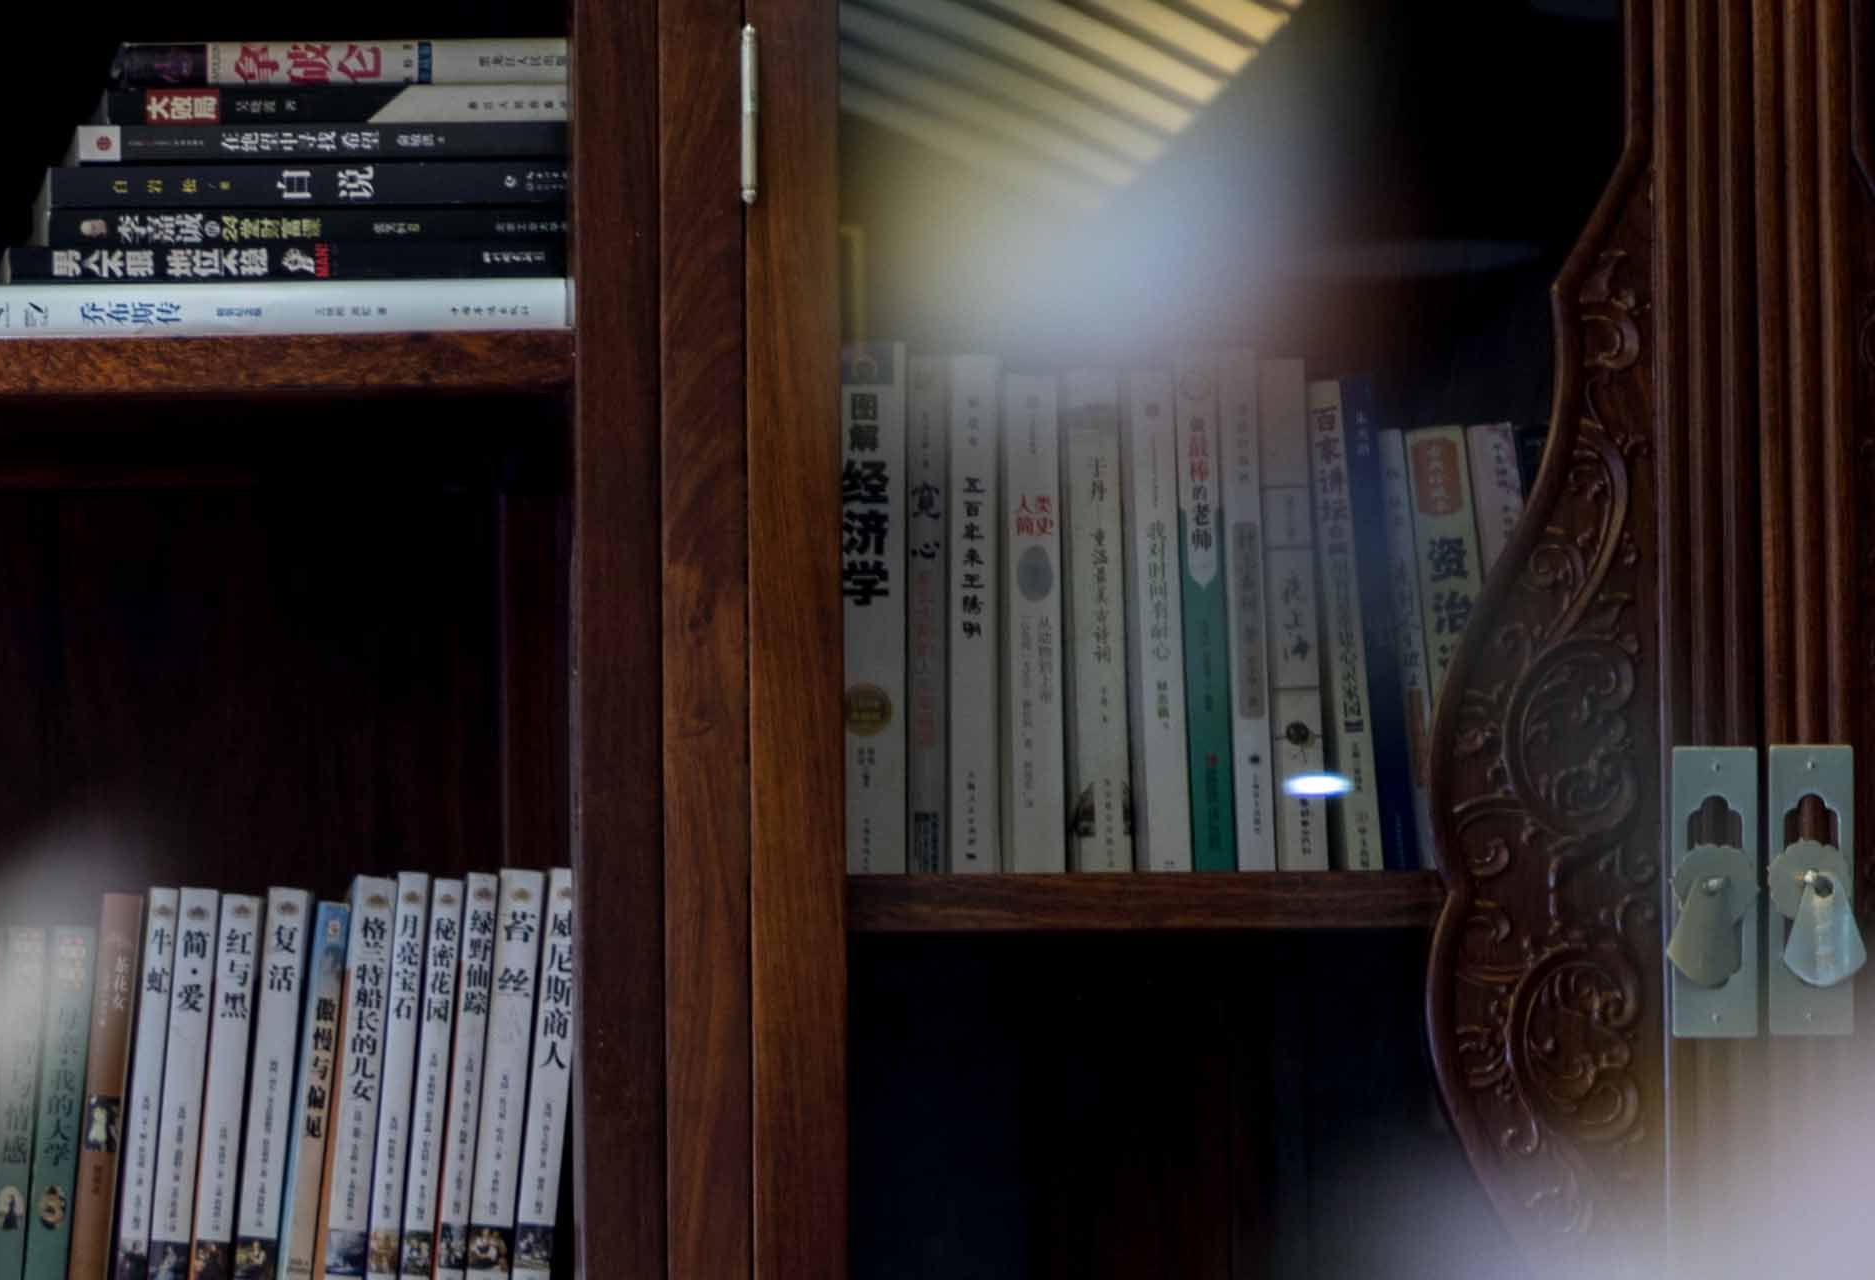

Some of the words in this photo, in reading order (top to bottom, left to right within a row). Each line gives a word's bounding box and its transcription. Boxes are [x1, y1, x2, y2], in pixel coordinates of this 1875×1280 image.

[234, 43, 382, 84] 拿破仑
[147, 95, 217, 119] 大败局
[221, 131, 380, 152] 在绝望中寻找希望
[113, 178, 198, 193] 白岩松
[277, 166, 374, 199] 白说
[53, 250, 155, 277] 男人不狠
[166, 248, 269, 277] 地位不稳
[80, 302, 181, 325] 乔布斯传
[848, 392, 879, 452] 图解
[841, 458, 890, 606] 经济学
[910, 483, 941, 560] 宽心
[1016, 516, 1052, 537] 简史
[1017, 494, 1052, 515] 人类
[960, 477, 986, 640] 五百年来王阳明
[145, 927, 173, 995] 牛虻
[177, 930, 211, 1013] 简·爱
[219, 928, 254, 1020] 红与黑
[267, 922, 298, 992] 复活
[393, 914, 420, 1021] 月亮宝石
[425, 916, 457, 1024] 秘密花园
[461, 910, 493, 1015] 绿野仙踪
[497, 910, 535, 999] 苔丝
[348, 916, 388, 1102] 格兰特船长的儿女
[541, 912, 572, 1071] 威尼斯商人
[303, 997, 343, 1139] 傲慢与偏见
